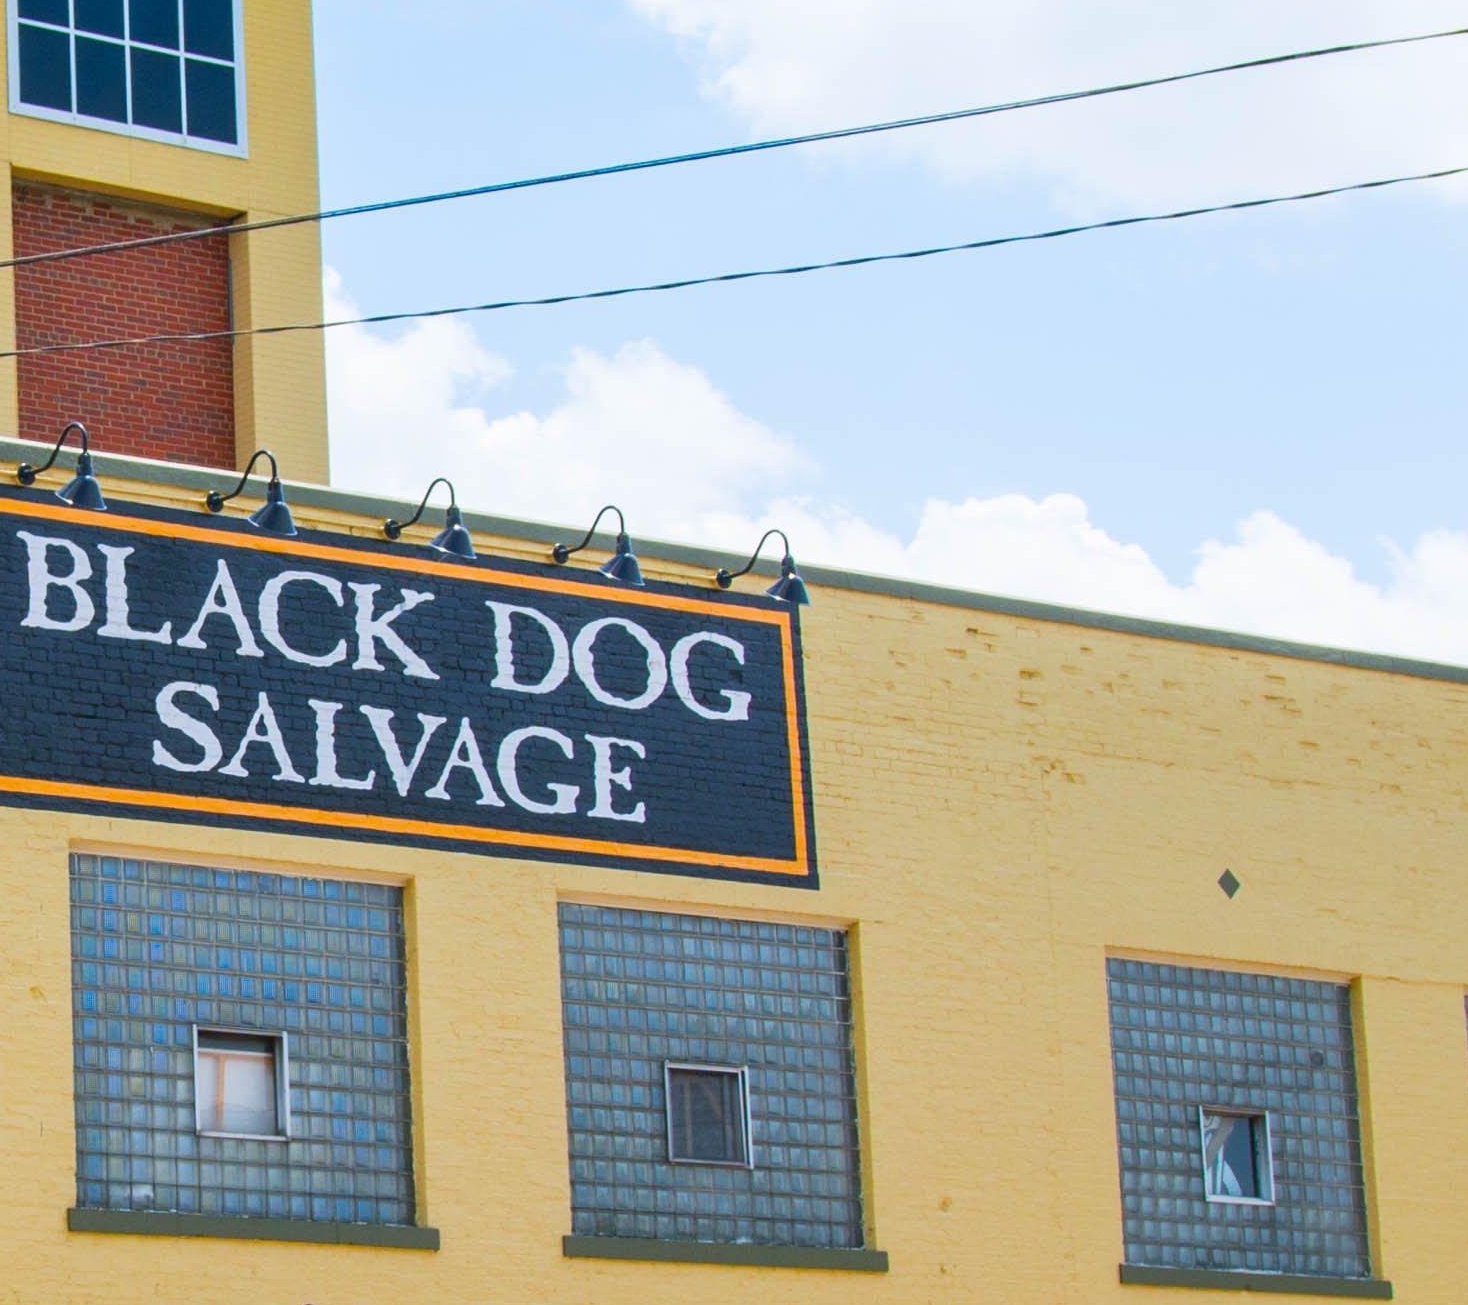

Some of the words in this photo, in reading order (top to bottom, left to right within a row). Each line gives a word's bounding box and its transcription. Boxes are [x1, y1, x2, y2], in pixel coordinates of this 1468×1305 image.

[16, 529, 439, 681] BLACK
[486, 600, 753, 722] DOG
[150, 680, 649, 825] SALVAGE
